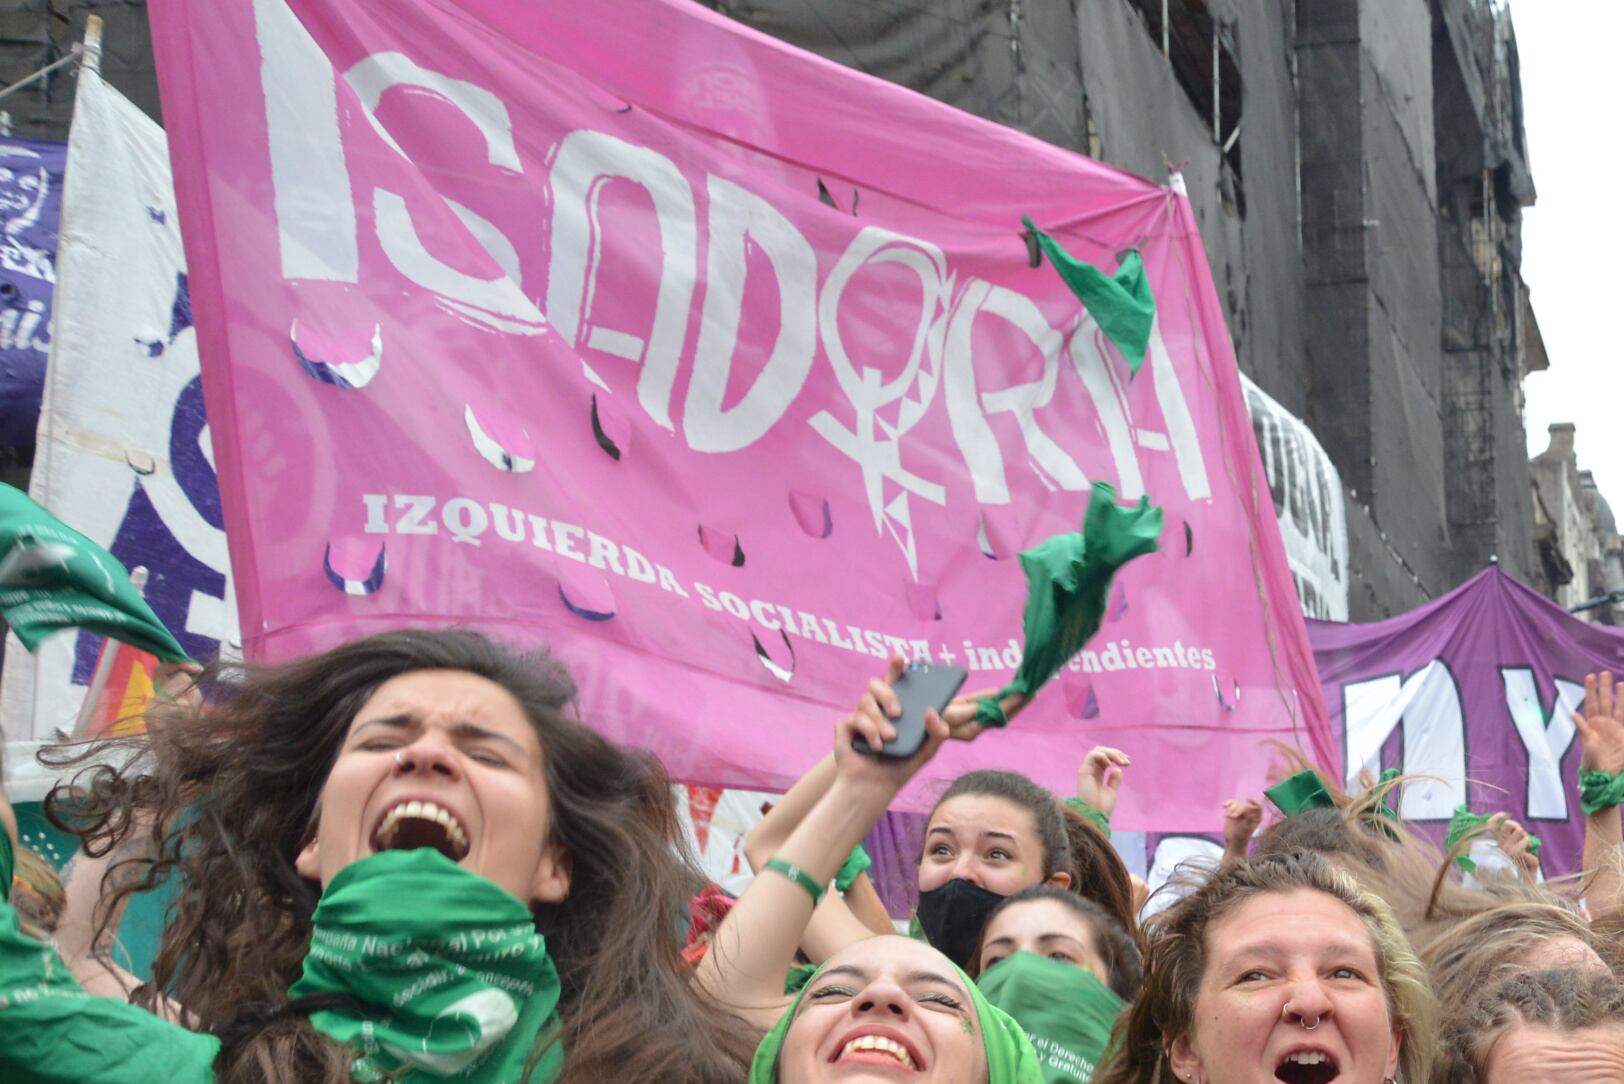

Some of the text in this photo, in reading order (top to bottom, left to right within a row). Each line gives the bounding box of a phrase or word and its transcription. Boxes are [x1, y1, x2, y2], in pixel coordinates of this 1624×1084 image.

[249, 0, 1212, 560] ISADORA
[361, 492, 691, 600] IZQUIERDA
[701, 583, 932, 666] SOCIALISTA
[961, 637, 1217, 680] indendientes
[1049, 1041, 1095, 1074] Derecho
